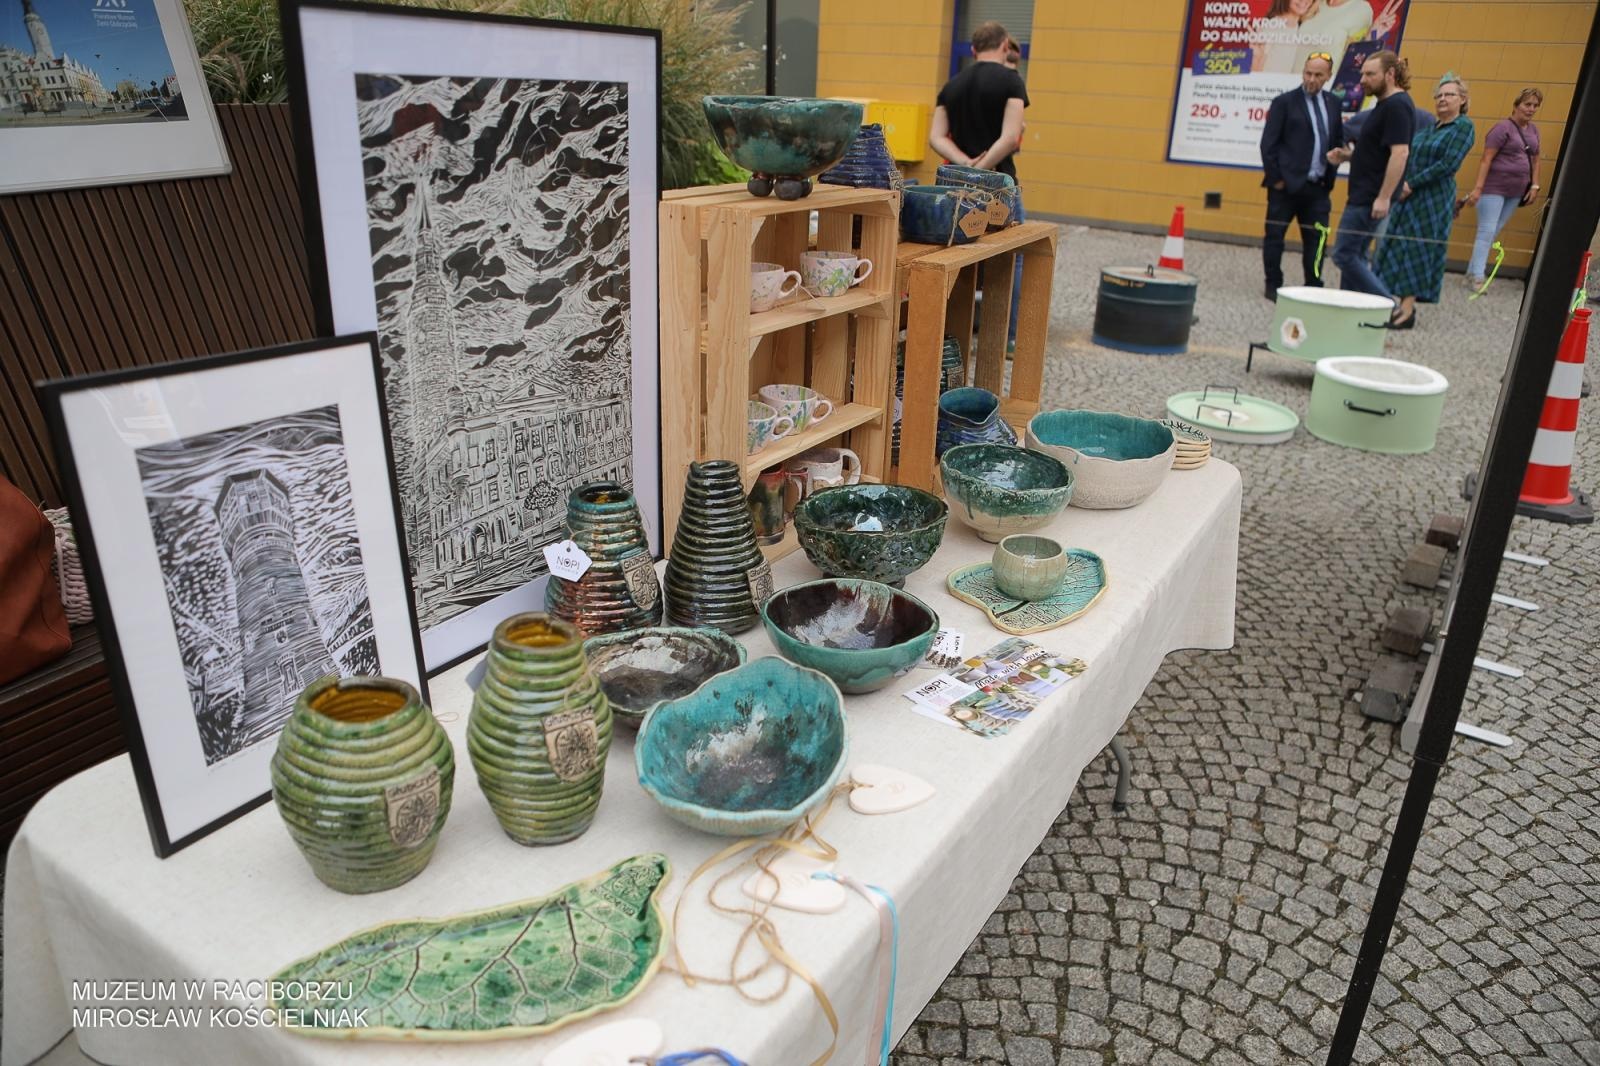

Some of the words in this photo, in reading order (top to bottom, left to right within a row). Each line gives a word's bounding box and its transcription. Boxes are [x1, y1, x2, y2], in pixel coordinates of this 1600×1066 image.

[1252, 16, 1288, 29] KROK
[1200, 30, 1221, 42] DO
[1190, 104, 1220, 118] 250
[556, 556, 581, 571] NOPI
[1001, 660, 1023, 675] with
[1022, 651, 1041, 662] love
[915, 679, 948, 698] NOPI
